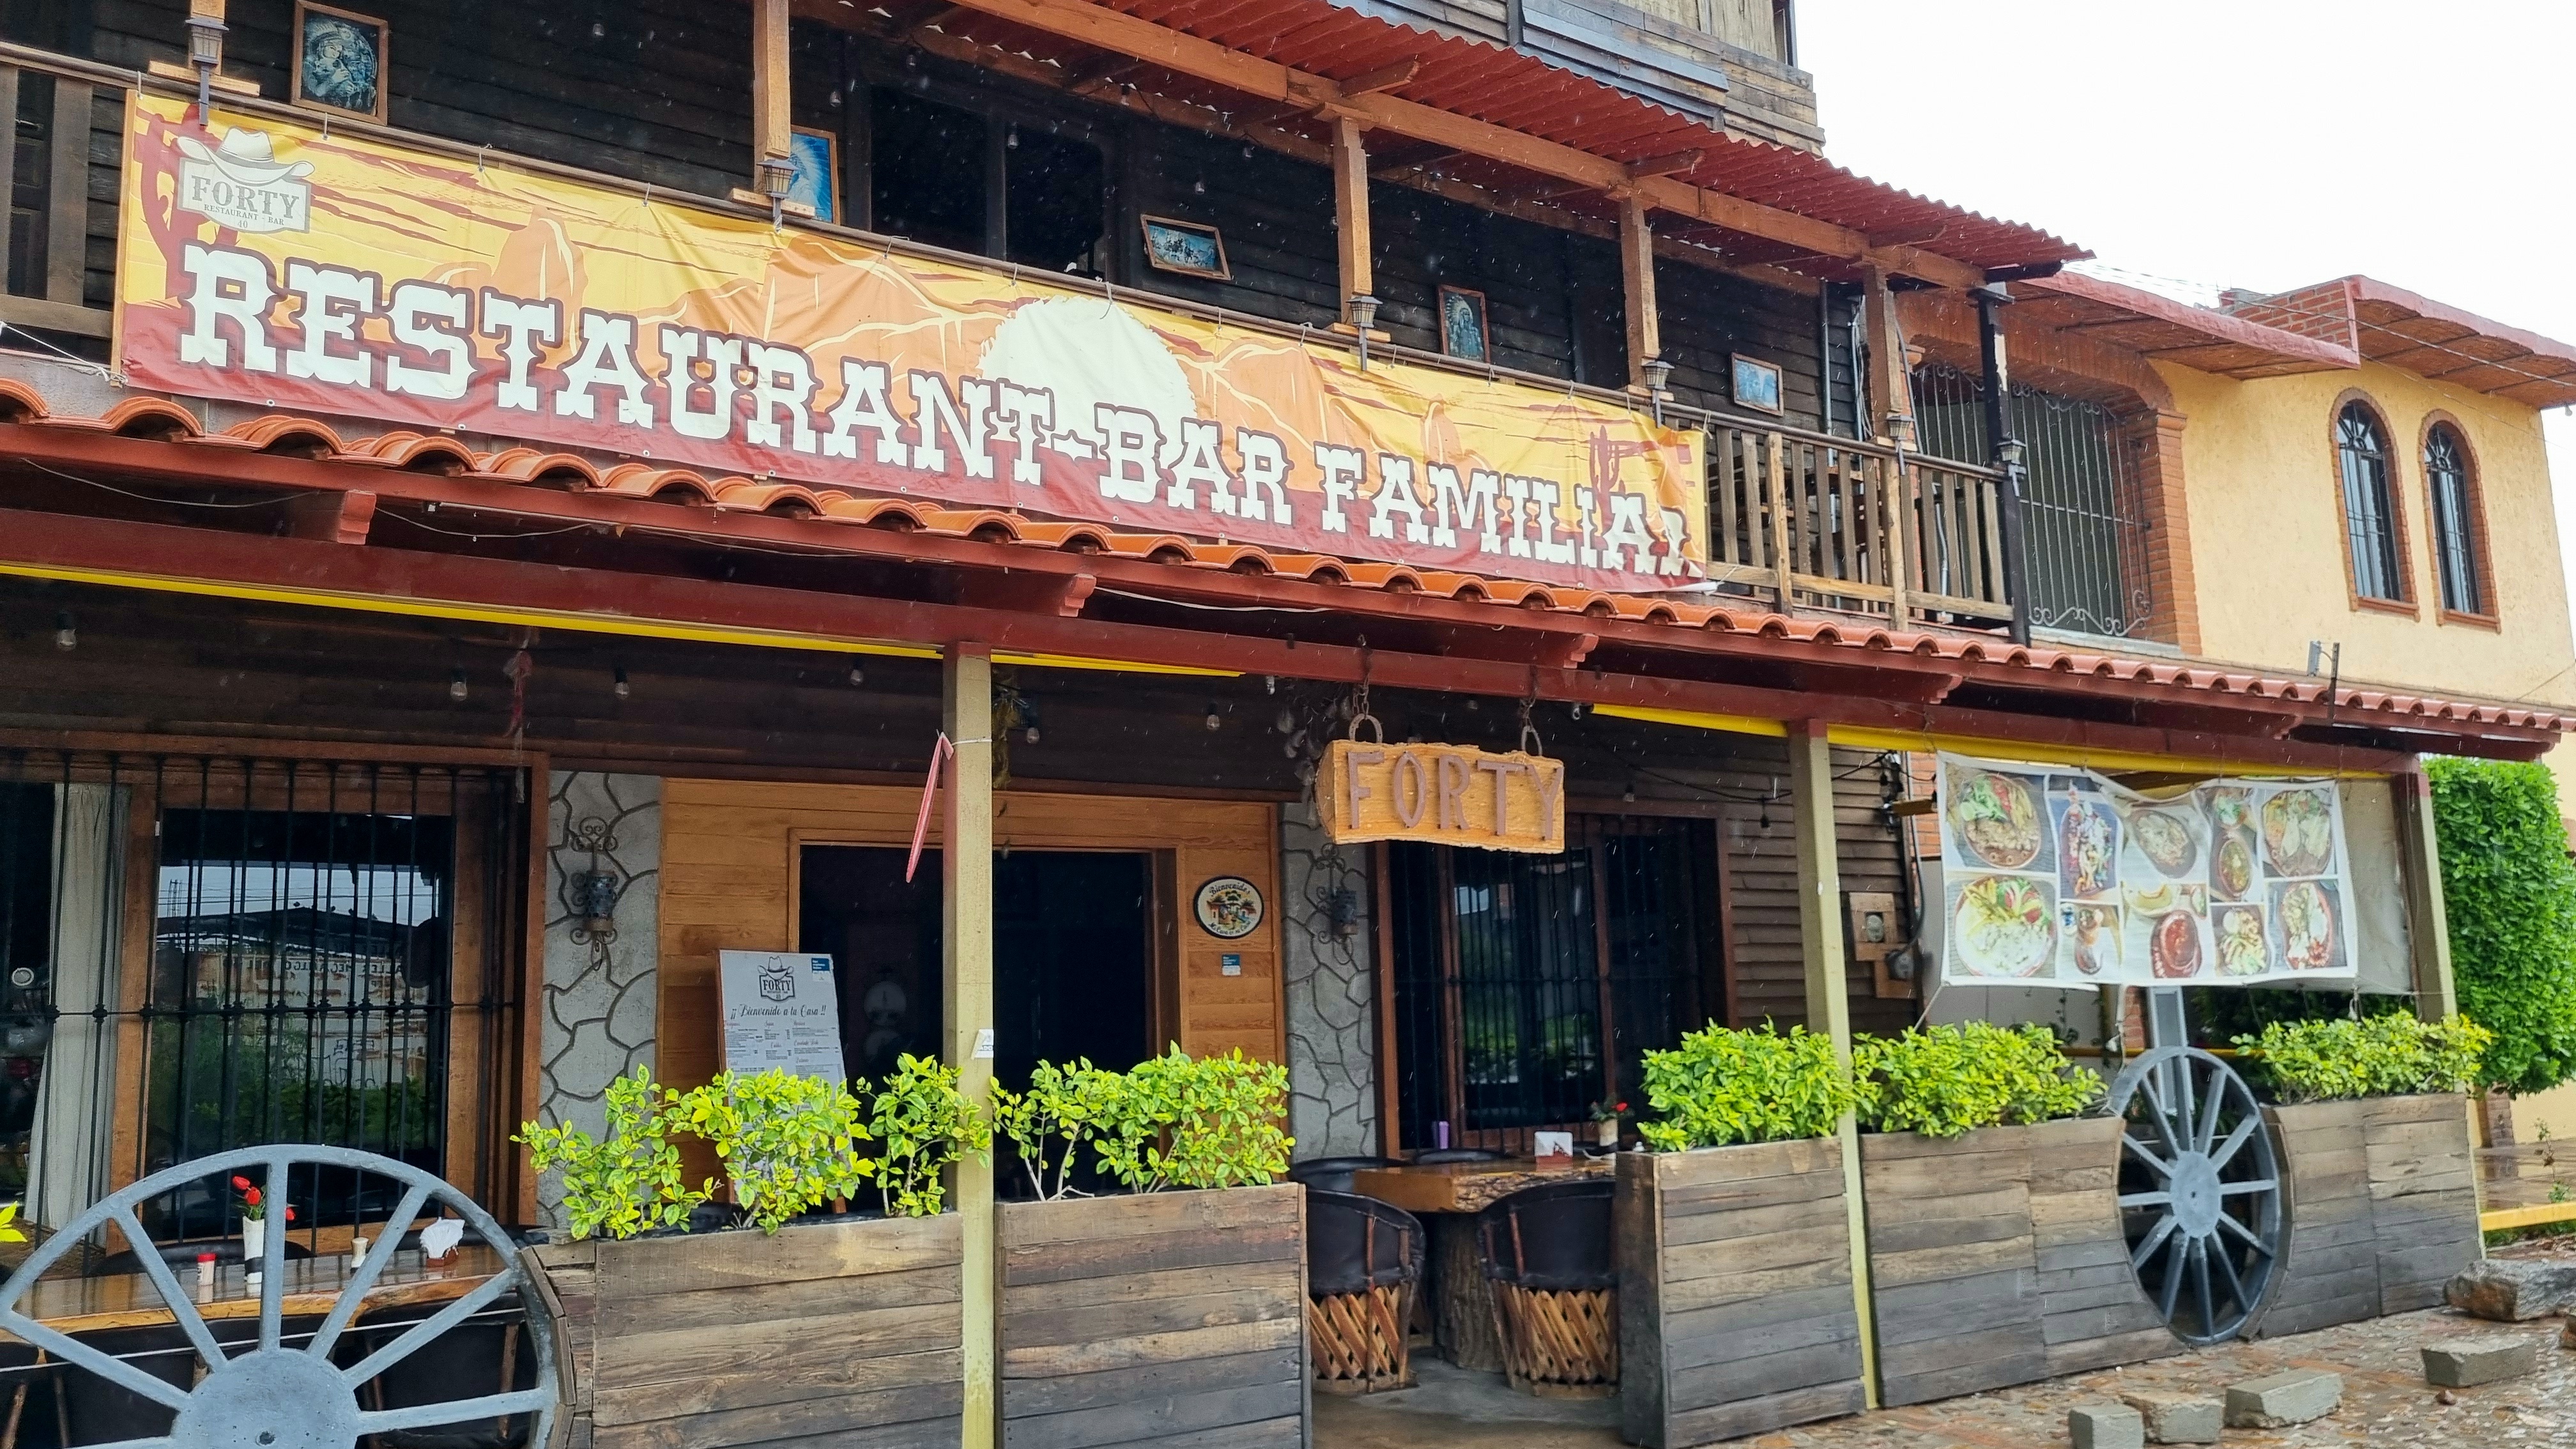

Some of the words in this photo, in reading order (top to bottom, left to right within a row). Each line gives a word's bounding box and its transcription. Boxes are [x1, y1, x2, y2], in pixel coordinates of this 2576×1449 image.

[191, 174, 300, 219] FORTY
[204, 204, 259, 220] RESTAURANT
[268, 216, 284, 226] BAR
[238, 220, 248, 229] 40
[1347, 750, 1564, 841] FORTY
[763, 979, 791, 990] FORTY
[739, 1004, 781, 1017] Bienvenido
[790, 1006, 797, 1016] la
[801, 1004, 818, 1017] Casa
